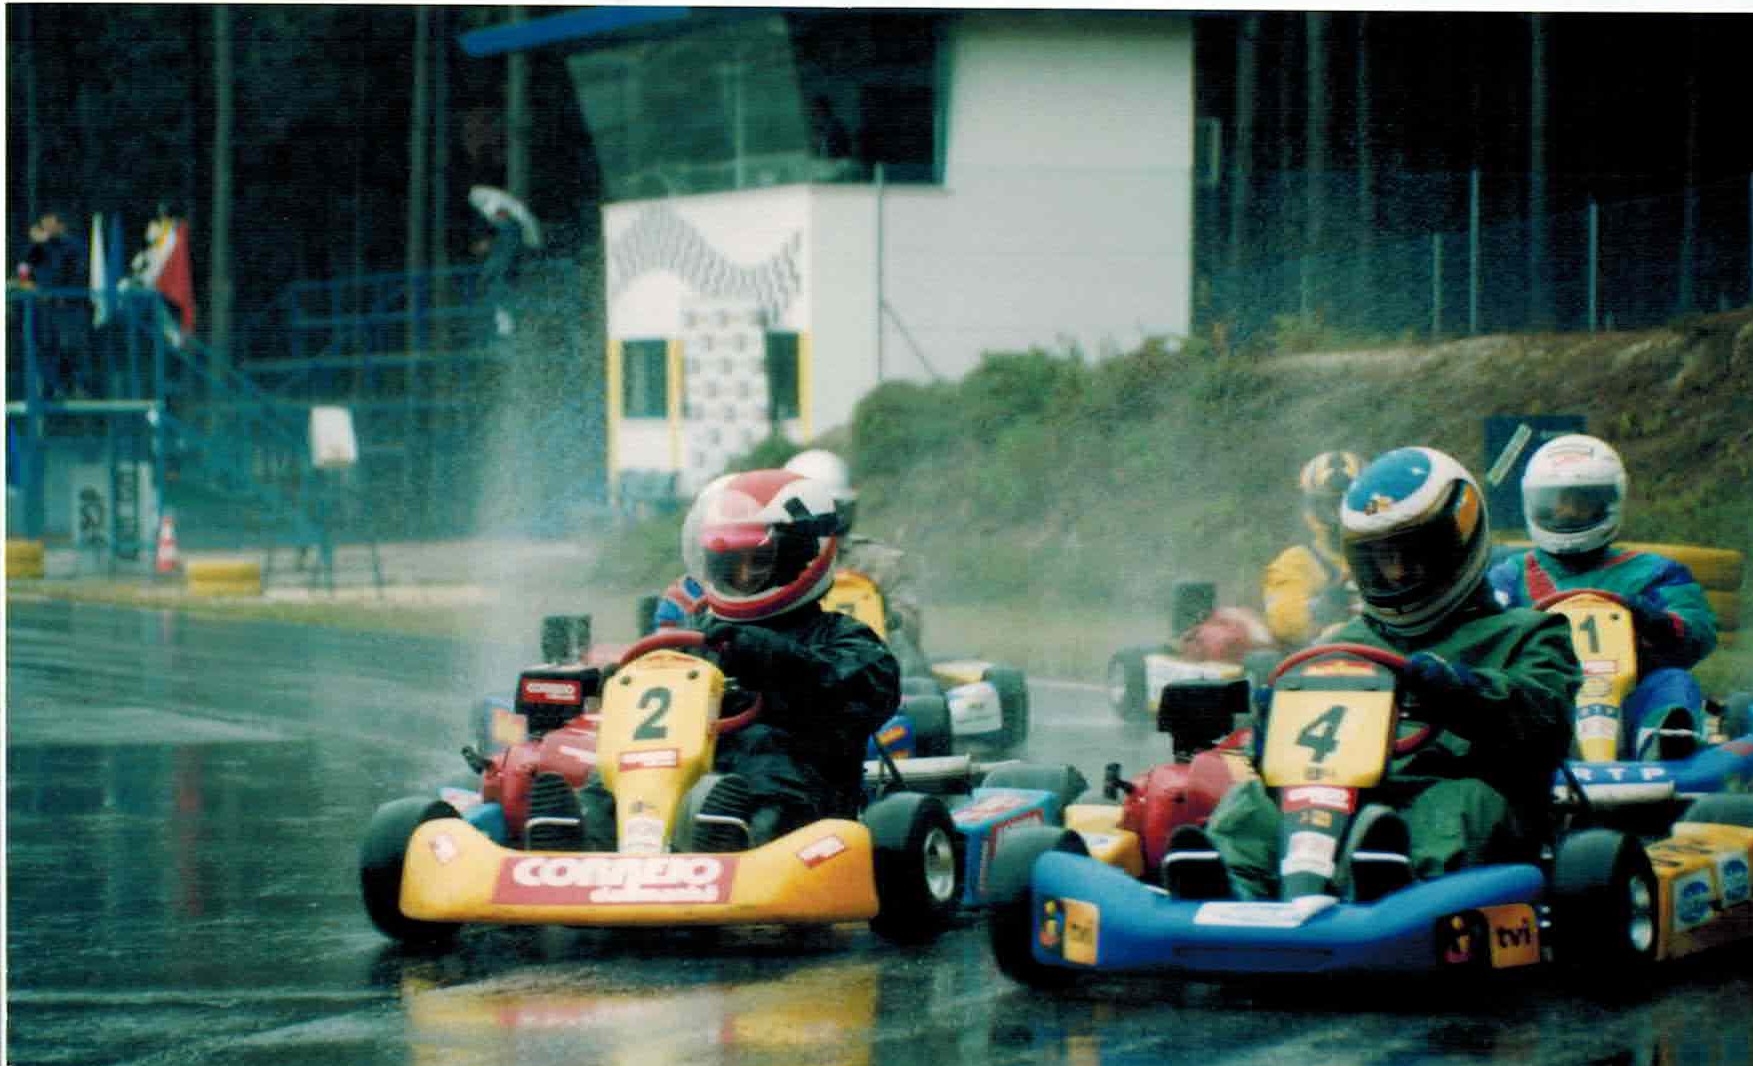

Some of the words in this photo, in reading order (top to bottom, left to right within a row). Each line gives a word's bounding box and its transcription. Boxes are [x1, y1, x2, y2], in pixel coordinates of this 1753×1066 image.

[1579, 614, 1599, 653] 1
[632, 686, 673, 741] 2
[1294, 704, 1349, 764] 4
[1497, 917, 1531, 949] tvi
